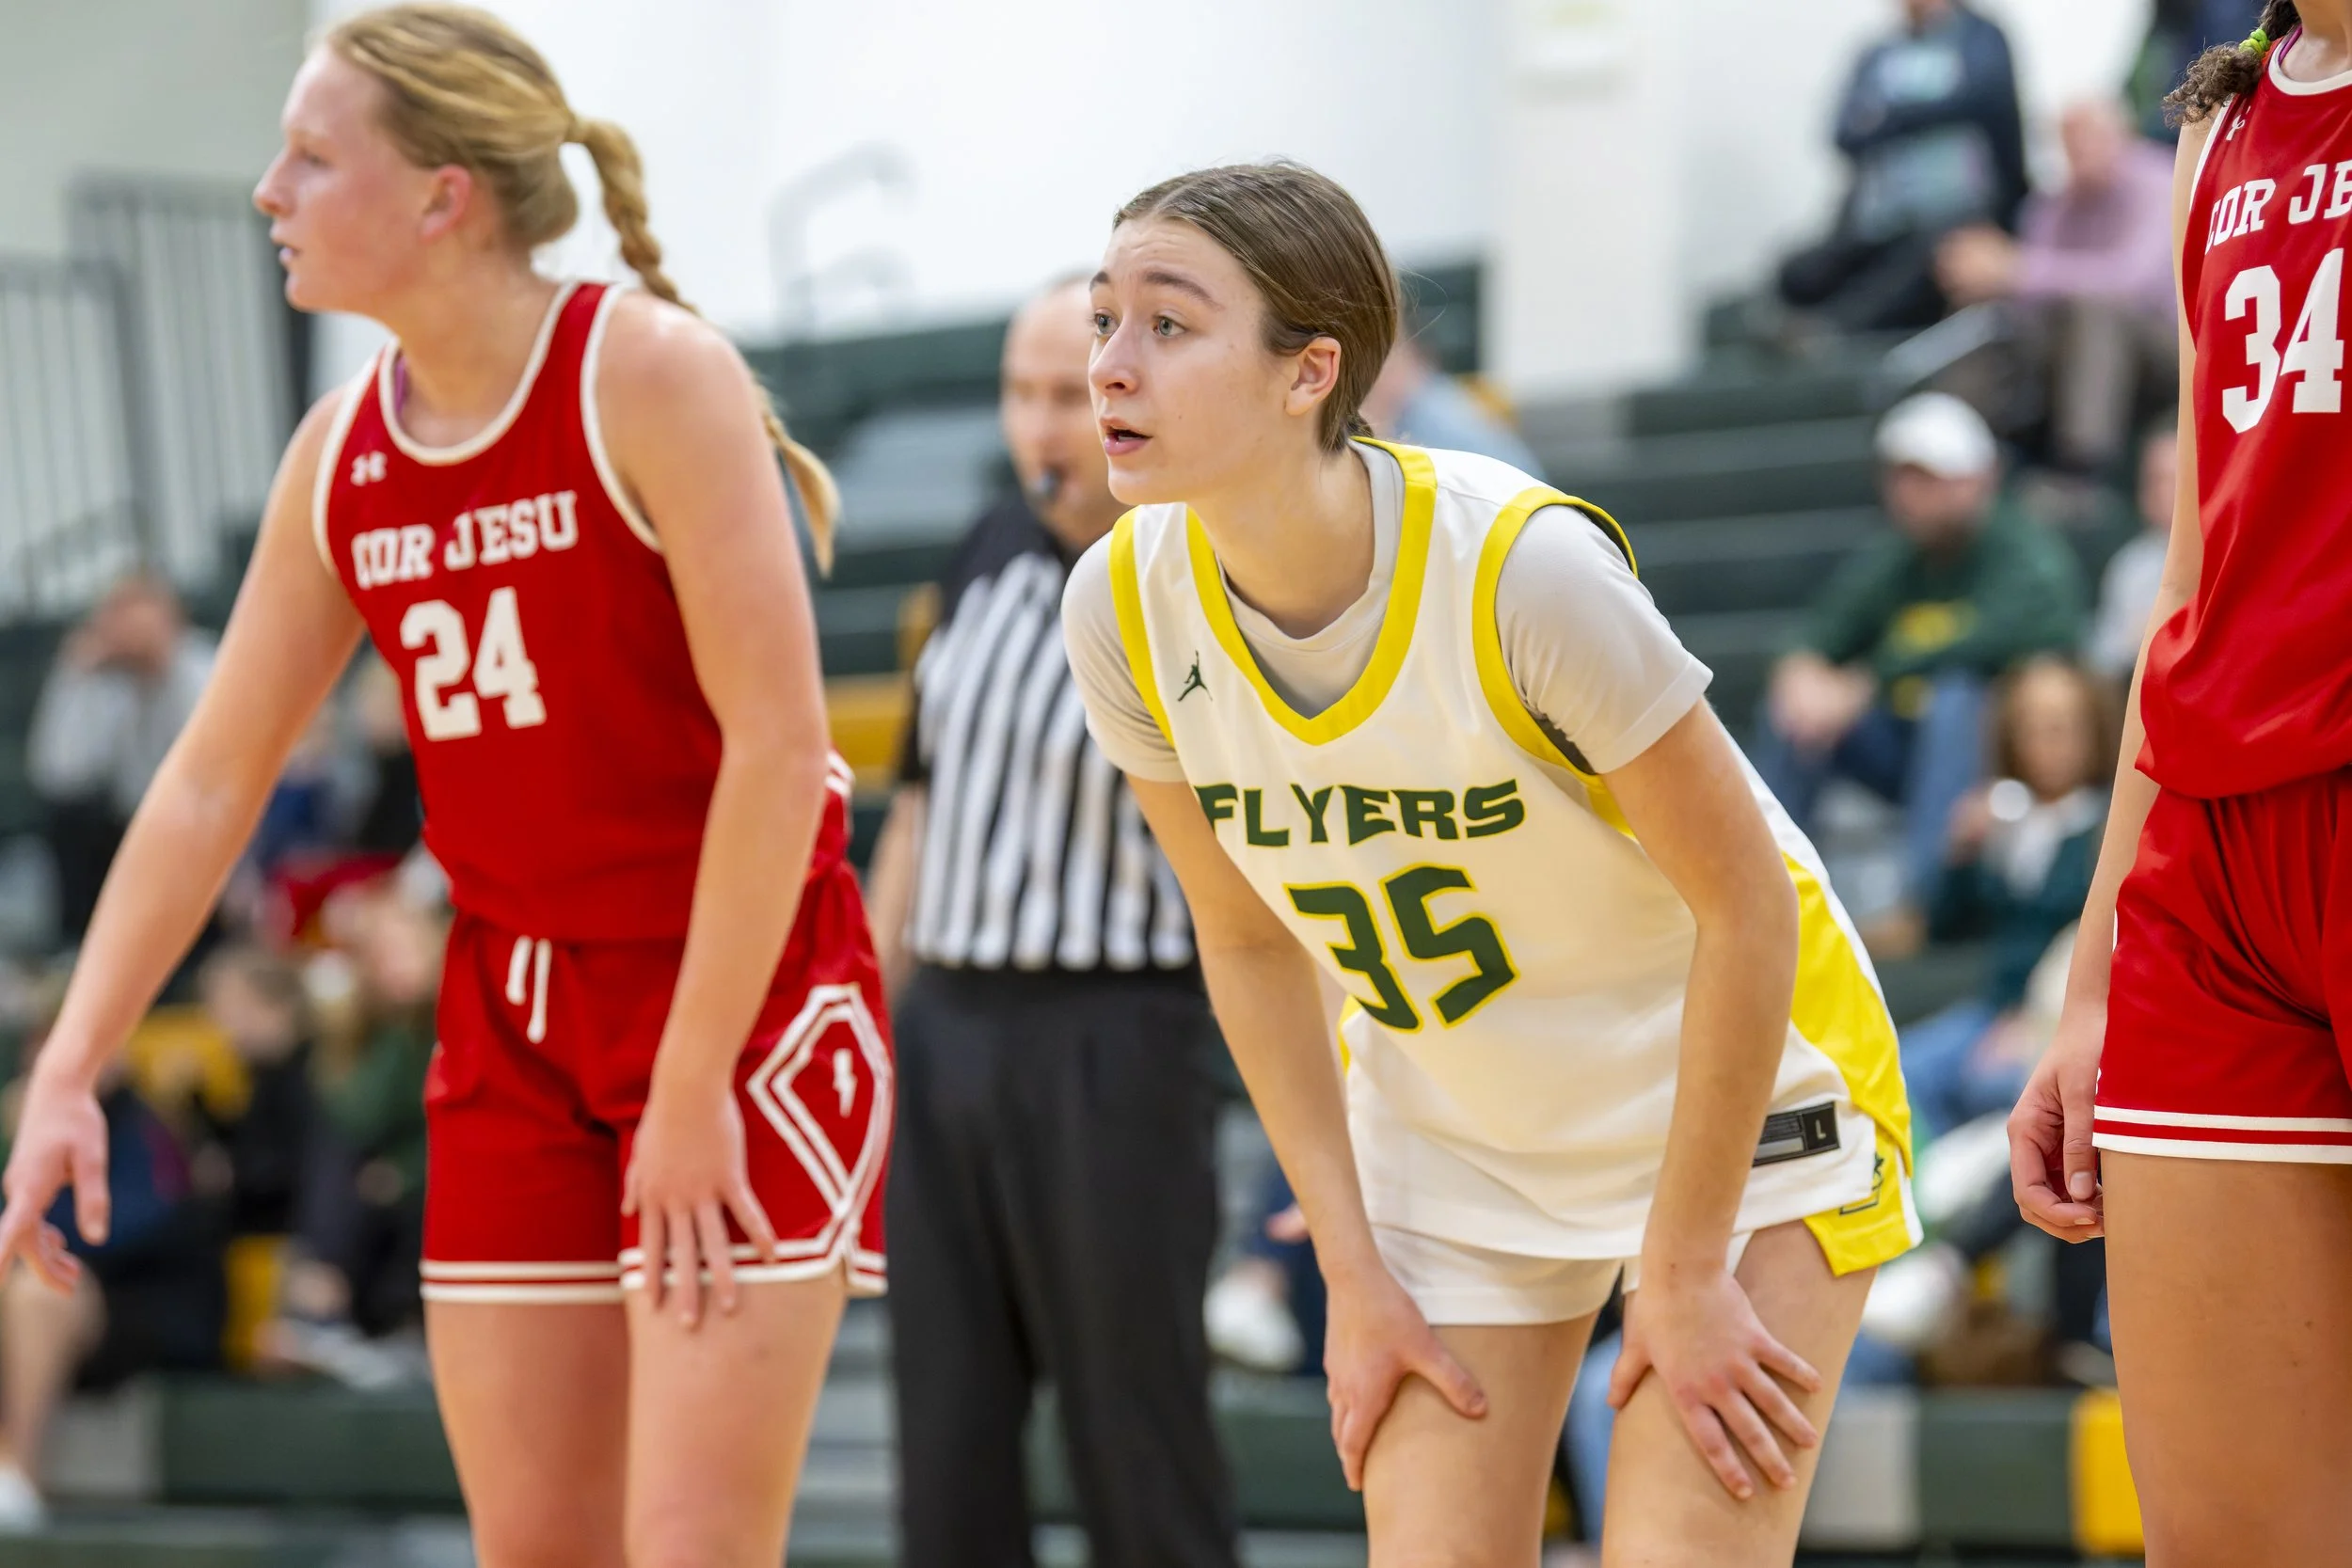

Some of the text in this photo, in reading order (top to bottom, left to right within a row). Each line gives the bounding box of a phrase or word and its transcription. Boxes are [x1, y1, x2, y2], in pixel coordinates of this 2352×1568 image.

[2204, 178, 2277, 256] COR
[2222, 247, 2344, 434] 34
[351, 490, 579, 591] COR JESU
[400, 585, 548, 741] 24
[1193, 779, 1526, 847] FLYERS
[1282, 862, 1521, 1034] 35
[1815, 1118, 1827, 1140] L
